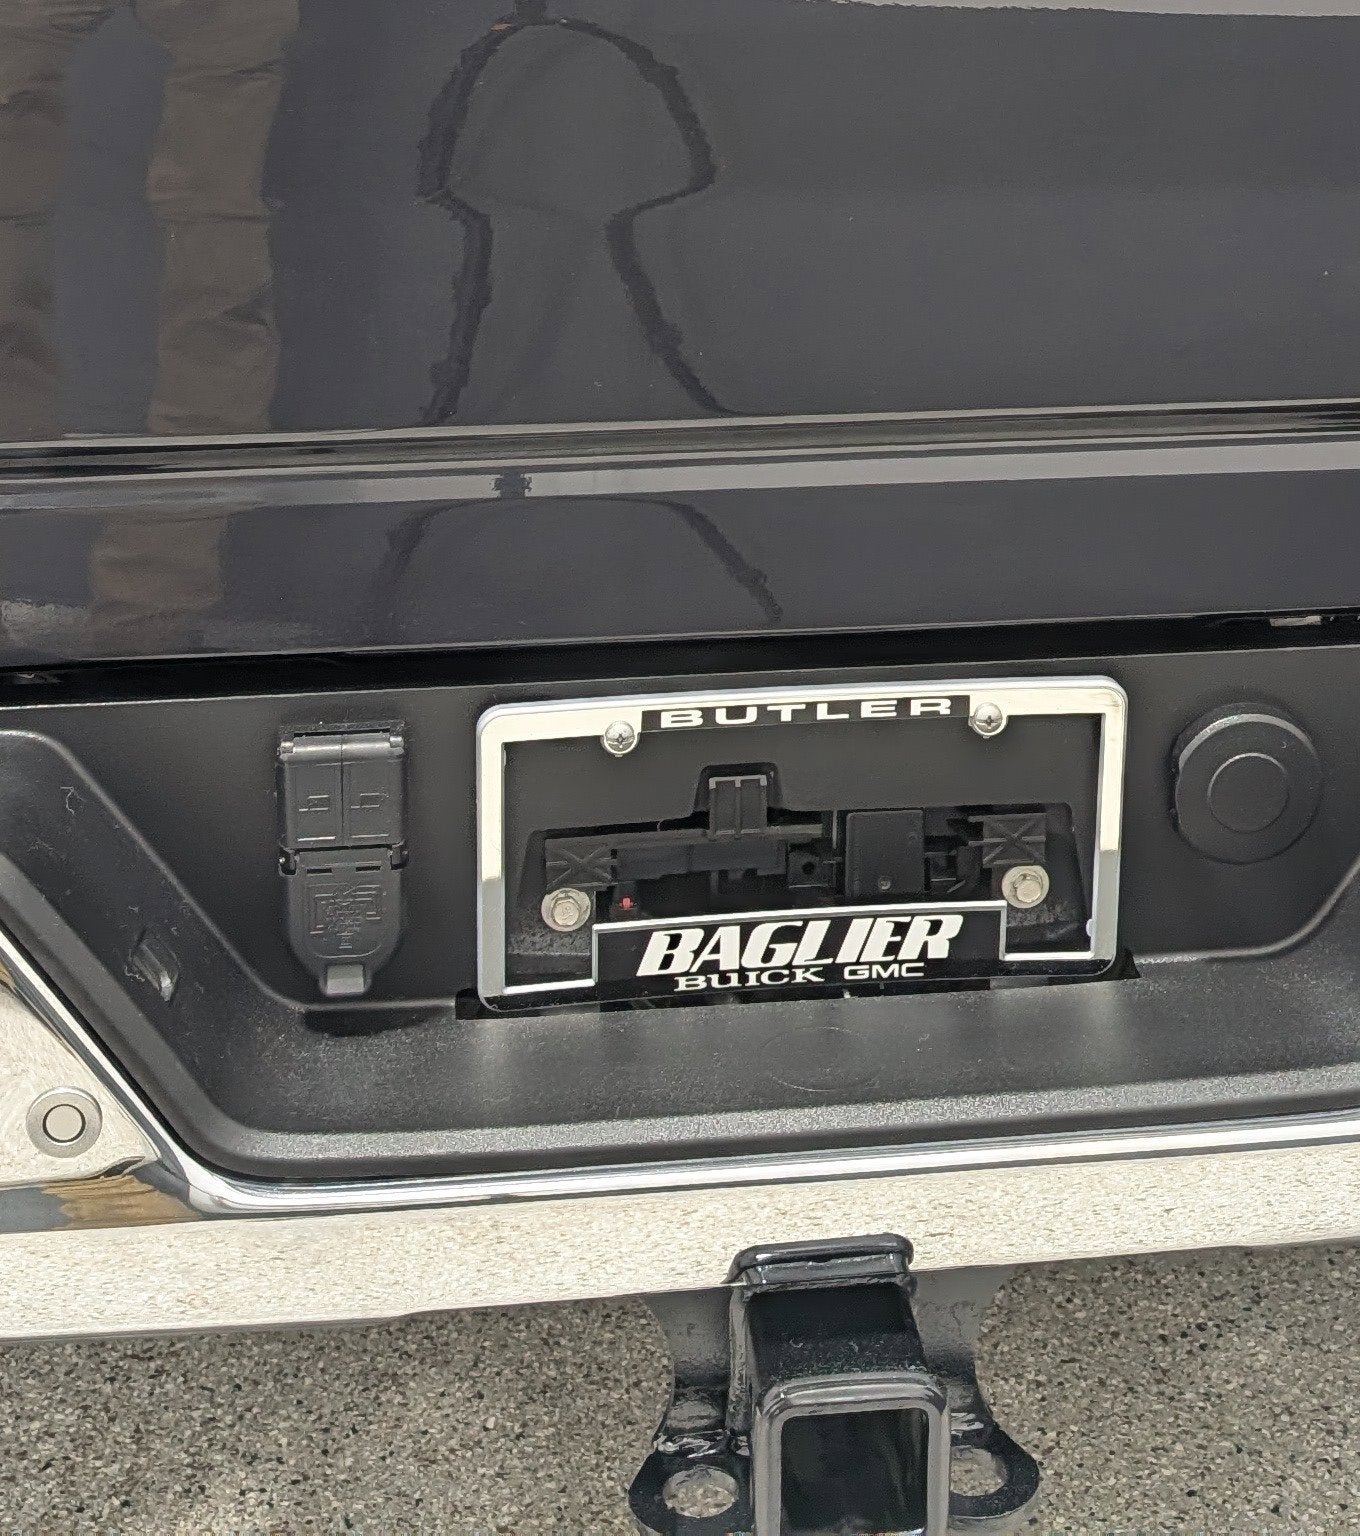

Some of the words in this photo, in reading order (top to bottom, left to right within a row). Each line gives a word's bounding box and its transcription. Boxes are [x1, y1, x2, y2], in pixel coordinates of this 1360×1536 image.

[660, 698, 952, 728] BUTLER
[636, 914, 963, 977] BAGLIER
[673, 966, 825, 992] BUICK
[843, 962, 925, 981] GMC
